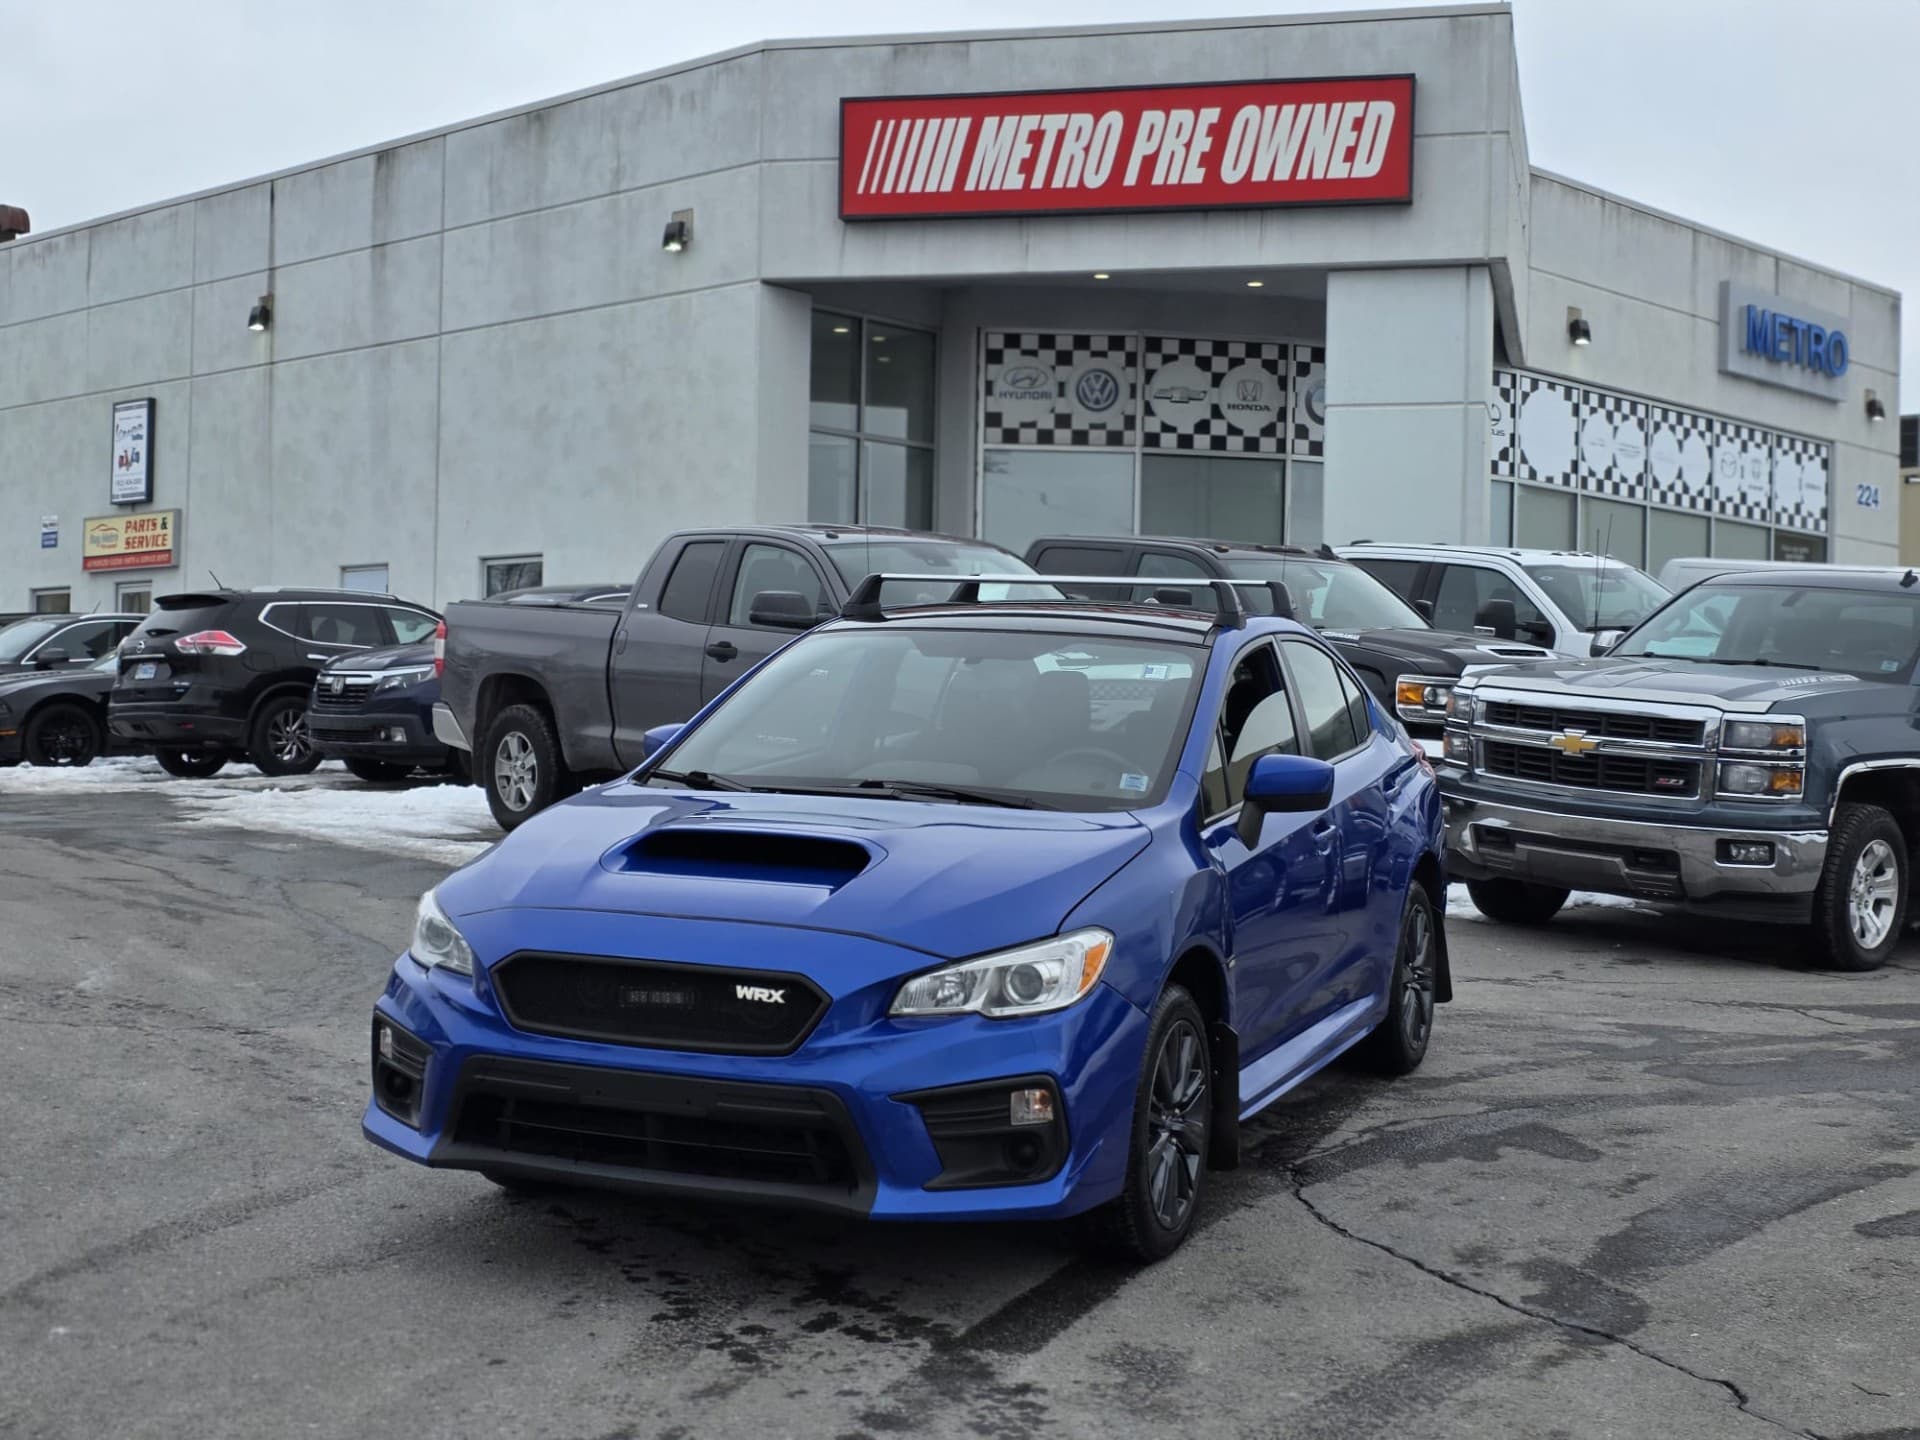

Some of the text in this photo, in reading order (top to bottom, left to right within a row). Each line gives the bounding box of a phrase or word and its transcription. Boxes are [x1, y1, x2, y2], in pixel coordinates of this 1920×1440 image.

[964, 100, 1396, 191] METRO PRE OWNED
[1746, 303, 1849, 377] METRO
[999, 390, 1053, 401] HYUNDAI
[1227, 402, 1272, 412] HONDA
[1857, 483, 1879, 508] 224
[124, 516, 169, 534] PARTS &
[123, 533, 169, 550] SERVICE
[735, 984, 786, 1004] WRX
